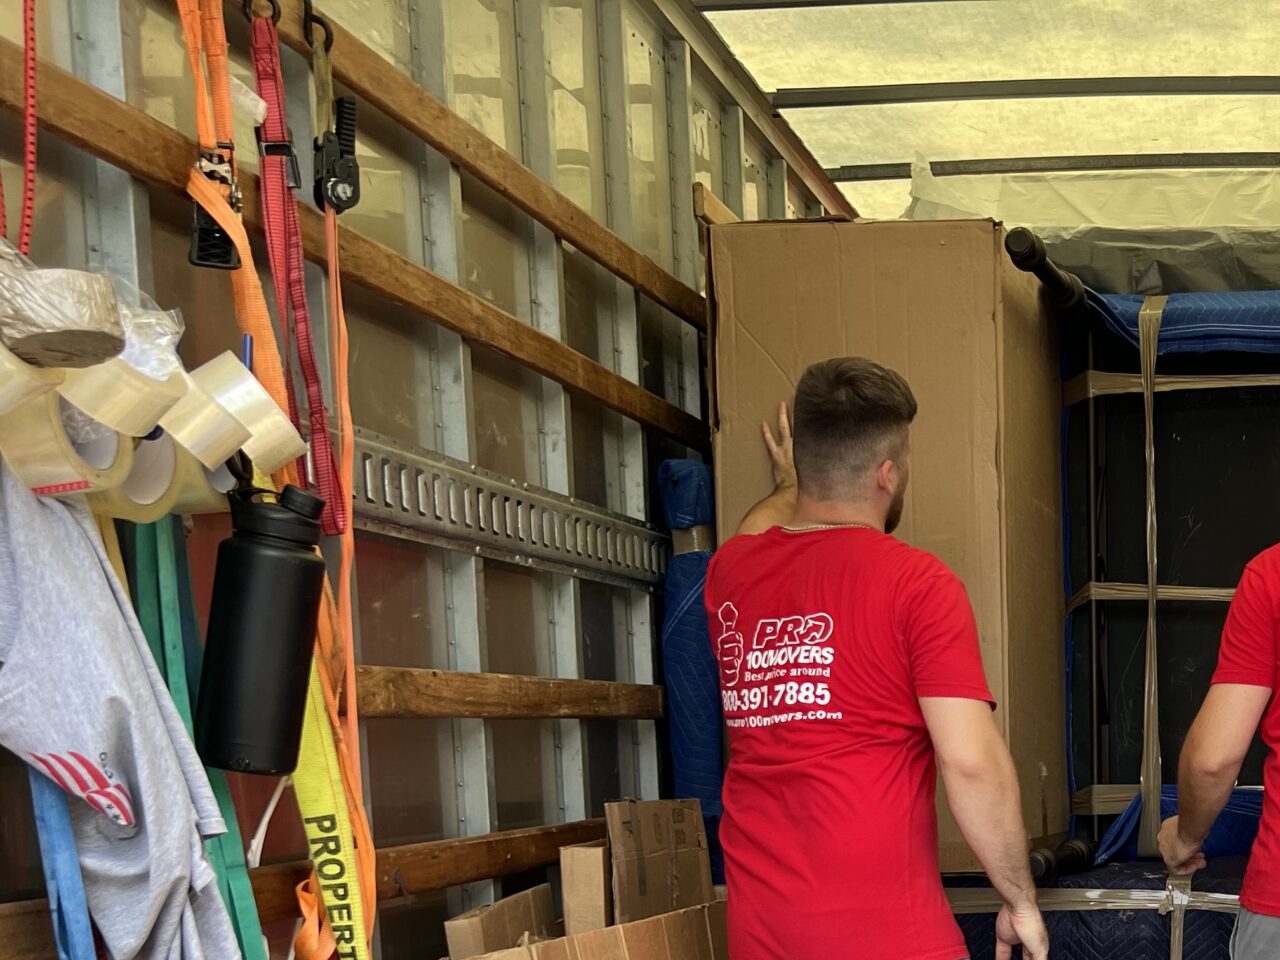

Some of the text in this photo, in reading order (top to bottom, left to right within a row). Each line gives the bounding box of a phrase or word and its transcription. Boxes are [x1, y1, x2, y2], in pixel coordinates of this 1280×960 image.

[752, 612, 834, 649] PRO
[746, 645, 835, 669] 100MOVERS
[744, 670, 765, 682] Best
[789, 667, 831, 678] around
